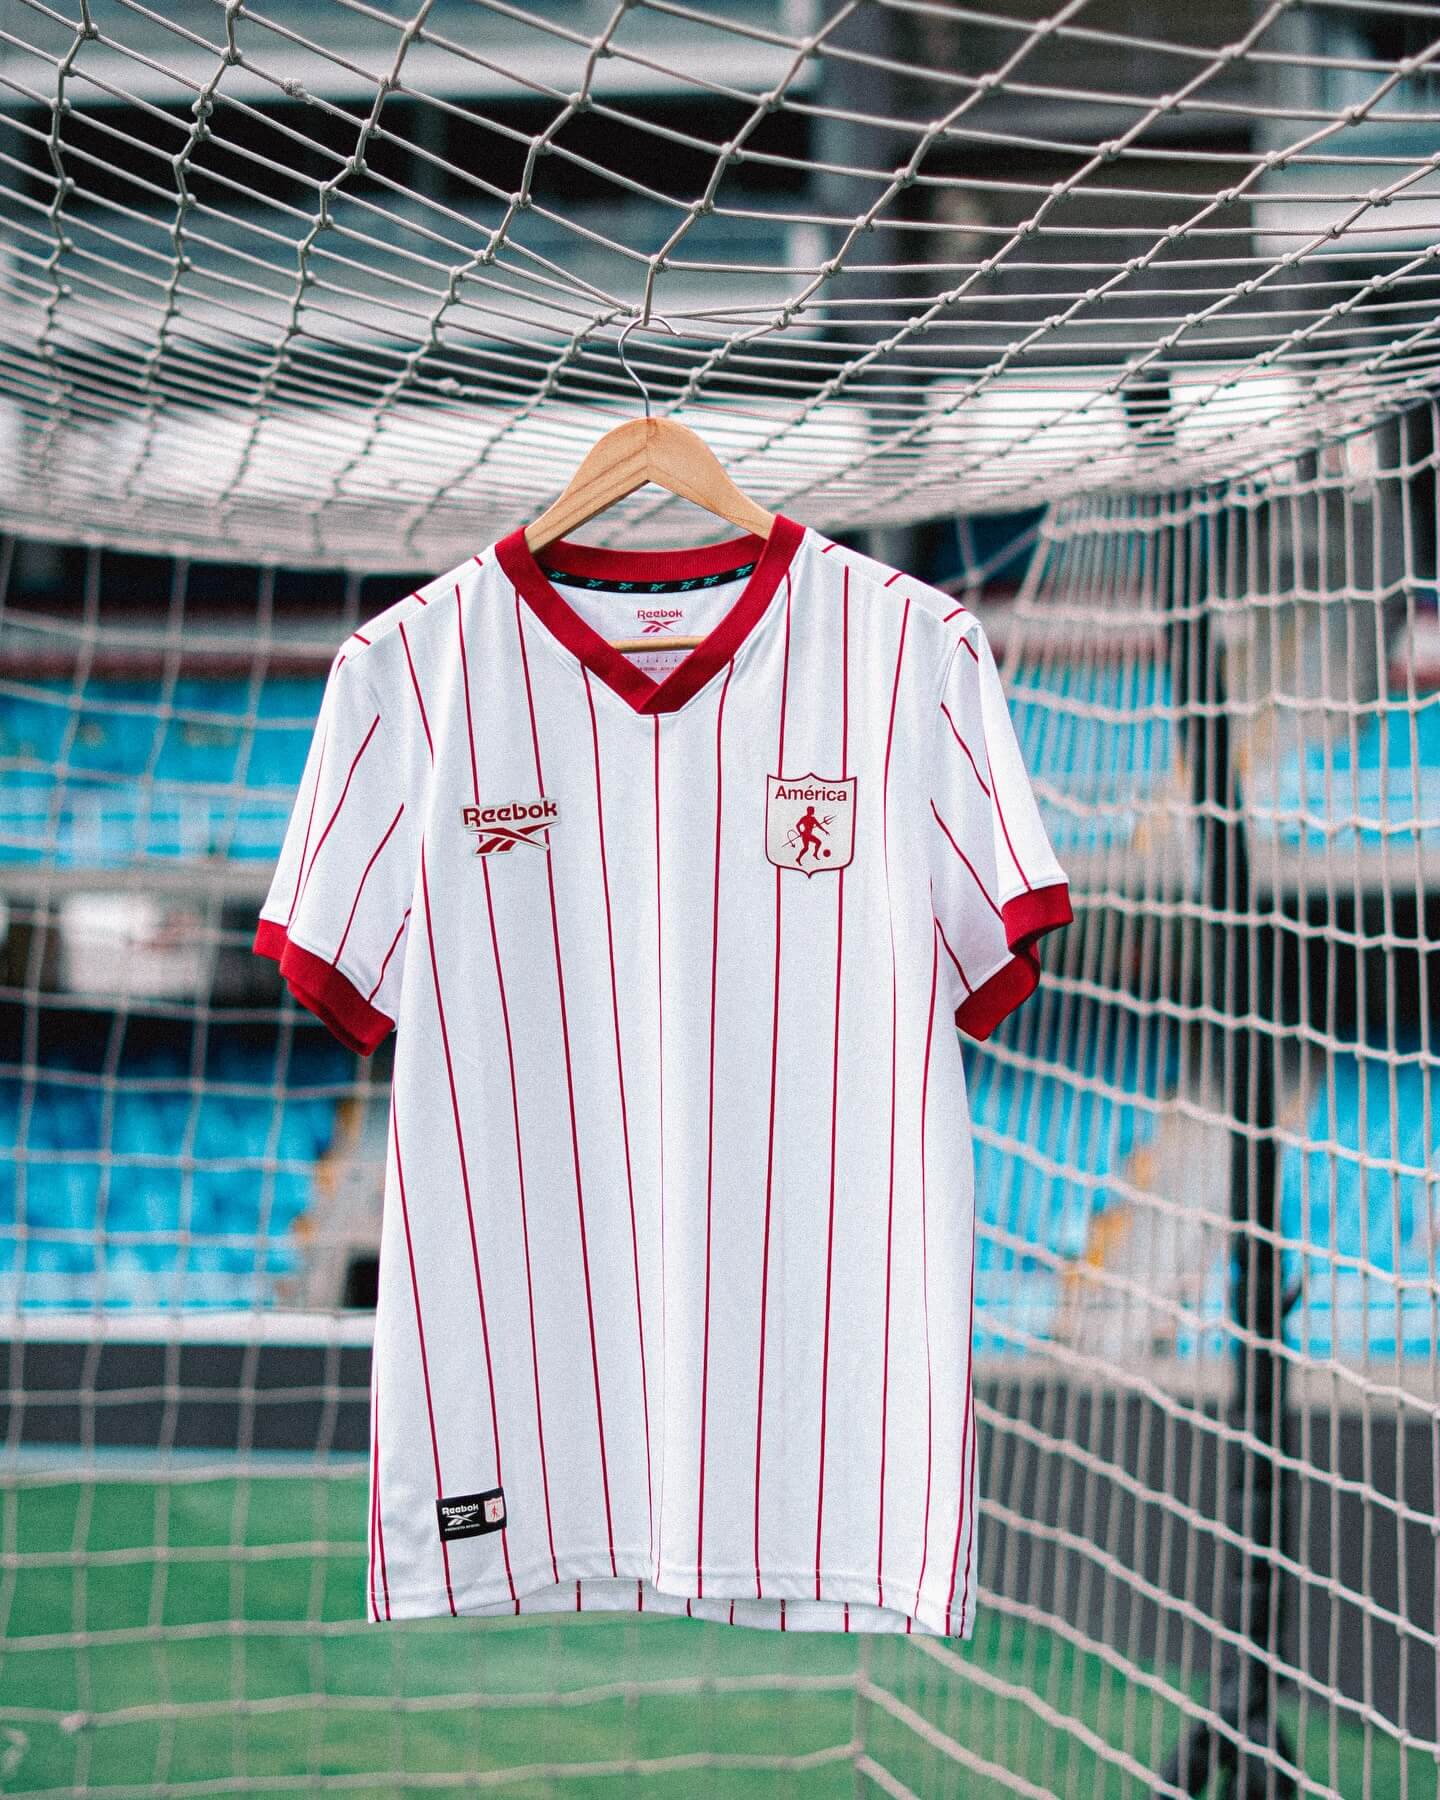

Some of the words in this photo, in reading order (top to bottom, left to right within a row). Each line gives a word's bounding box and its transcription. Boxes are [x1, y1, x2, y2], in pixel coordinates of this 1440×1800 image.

[637, 608, 683, 620] Reebok
[775, 785, 847, 801] América
[463, 800, 557, 827] Reebok
[441, 1504, 479, 1516] Reebok
